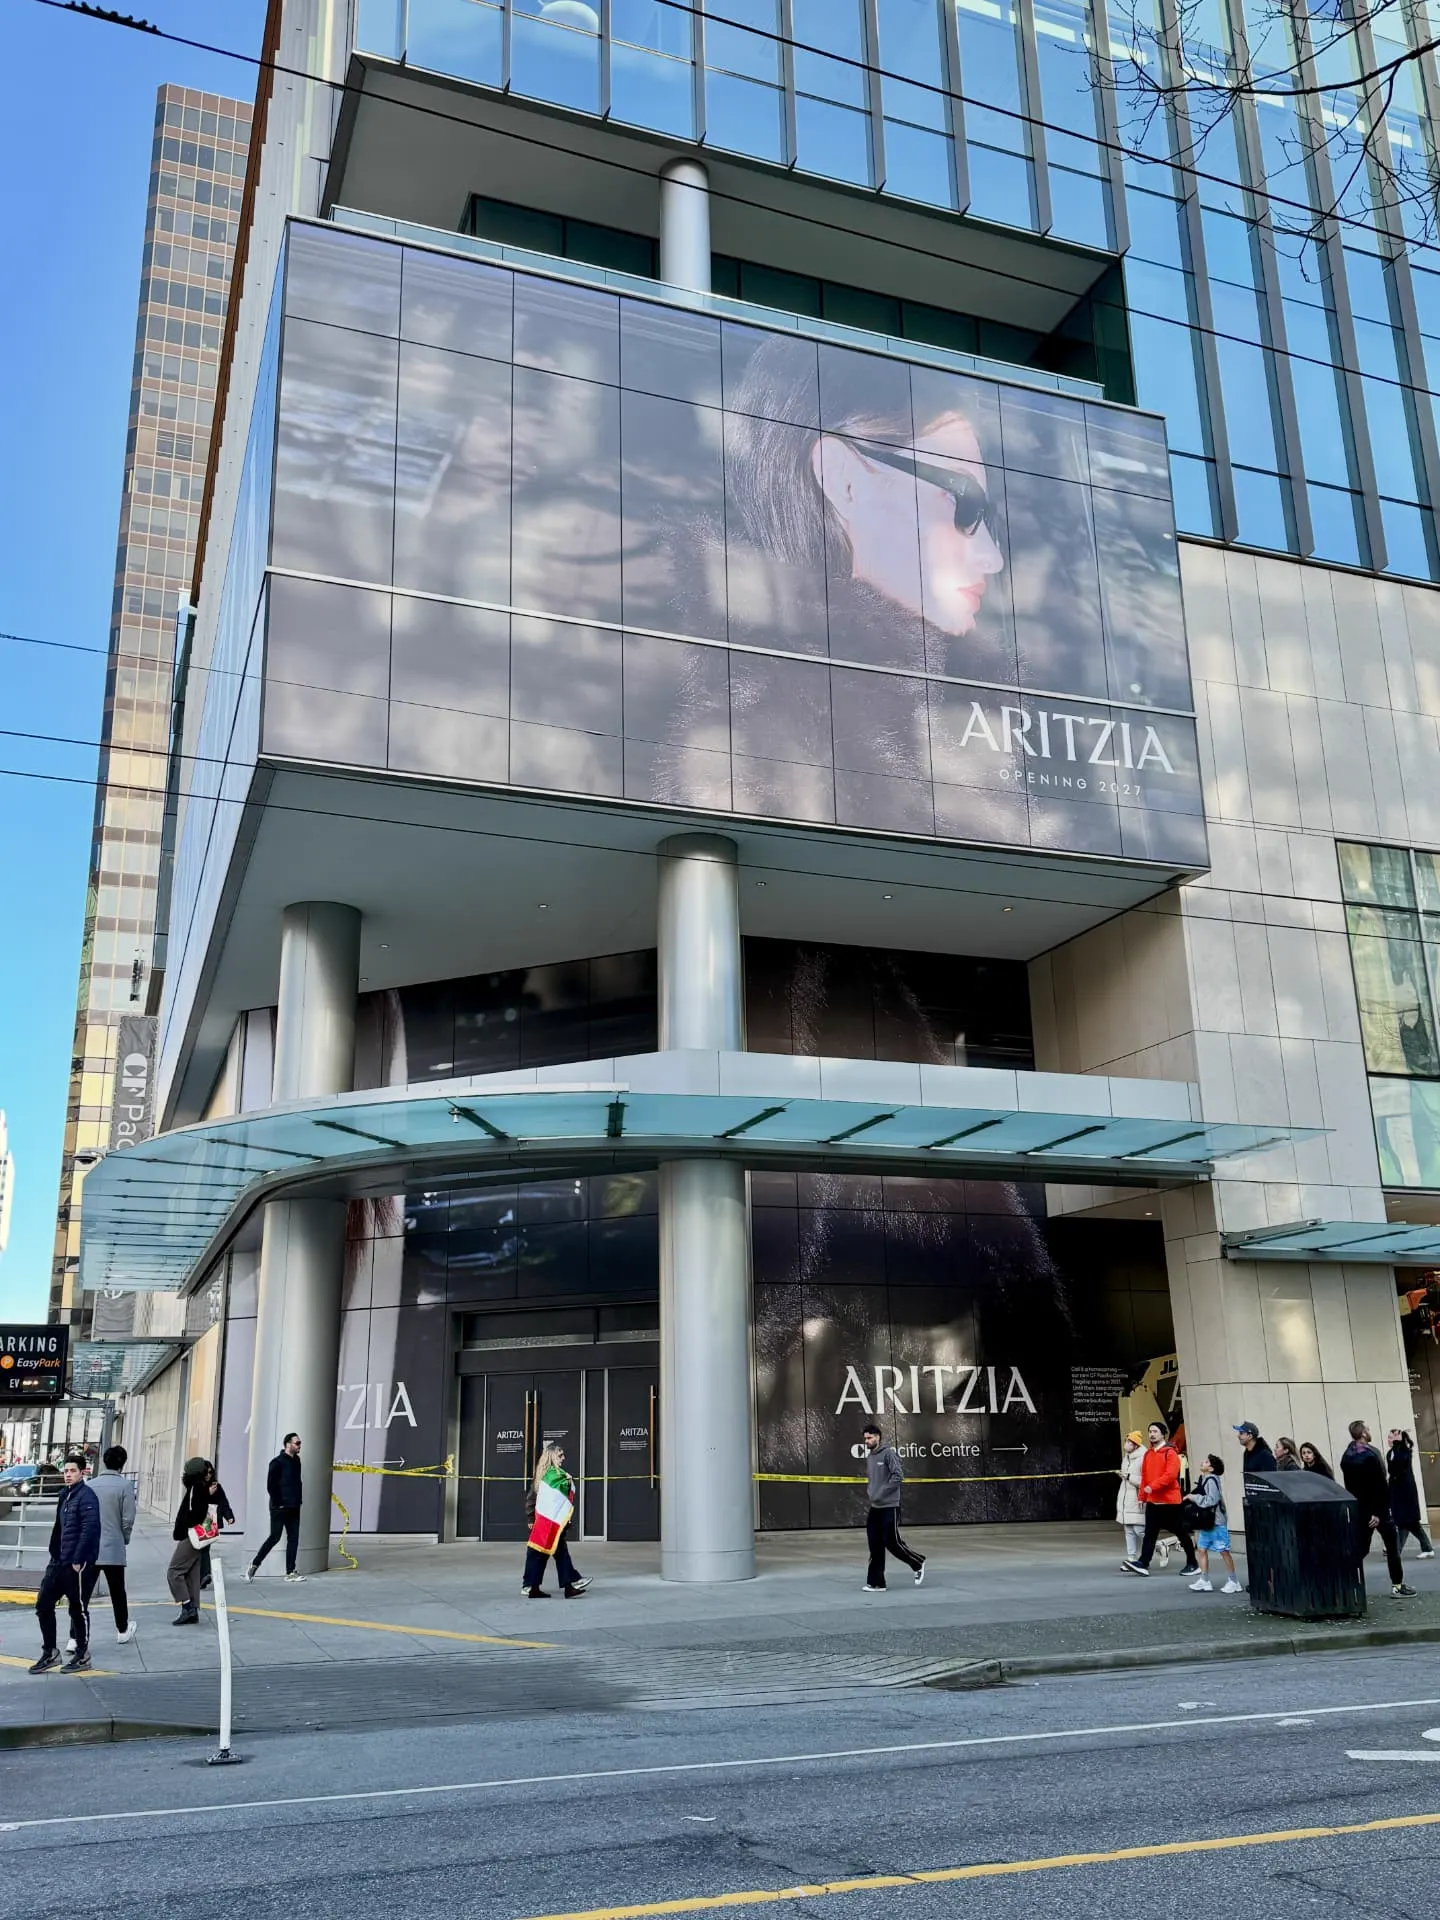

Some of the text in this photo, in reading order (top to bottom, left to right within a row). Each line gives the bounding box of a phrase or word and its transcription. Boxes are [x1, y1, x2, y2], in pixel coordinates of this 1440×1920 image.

[959, 701, 1175, 774] ARITZIA
[999, 768, 1142, 797] OPENING 2027
[16, 1357, 61, 1370] EasyPark
[9, 1378, 20, 1389] EV
[835, 1365, 1038, 1415] ARITZIA
[496, 1430, 524, 1440] ARITZIA
[619, 1427, 649, 1437] ARITZIA
[889, 1442, 927, 1458] cific
[930, 1442, 981, 1458] Centre
